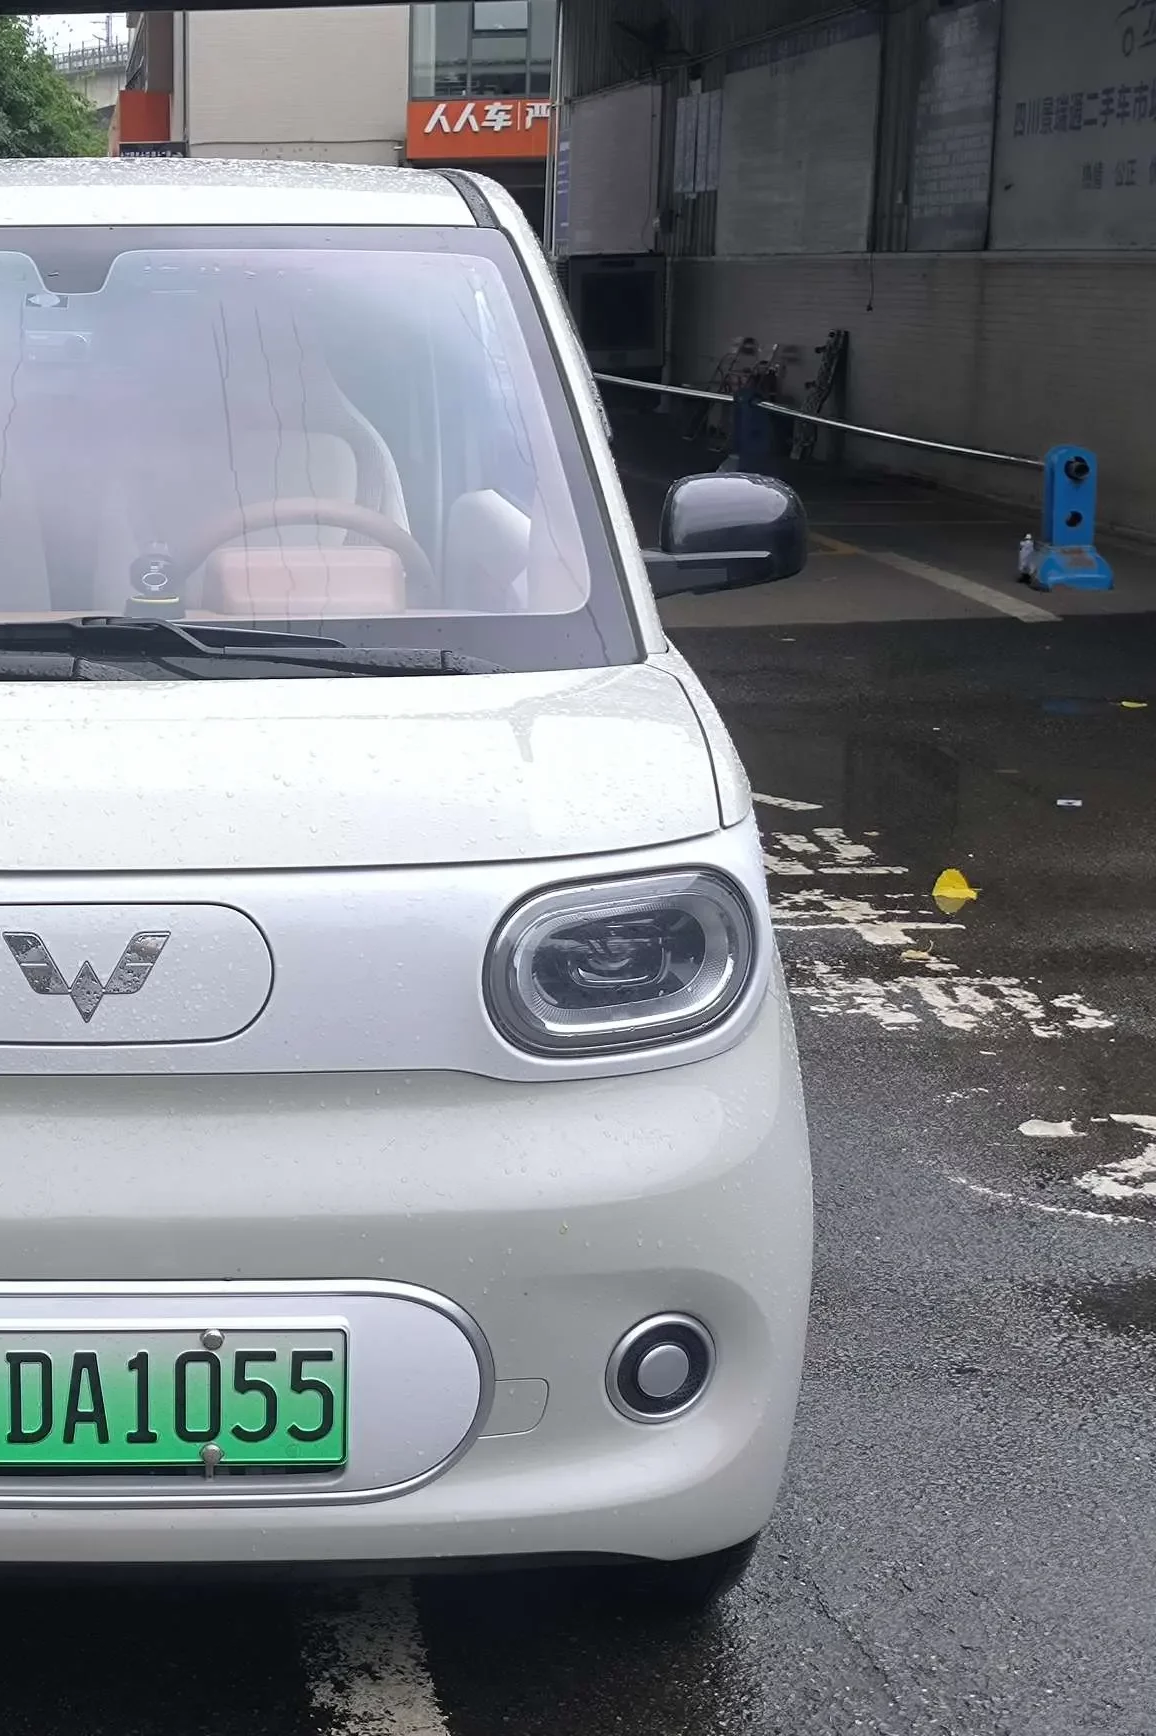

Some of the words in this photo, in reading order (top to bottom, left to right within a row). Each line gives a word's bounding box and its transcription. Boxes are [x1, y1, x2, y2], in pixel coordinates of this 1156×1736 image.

[424, 101, 513, 133] 人人车
[5, 1350, 335, 1444] DA1055
